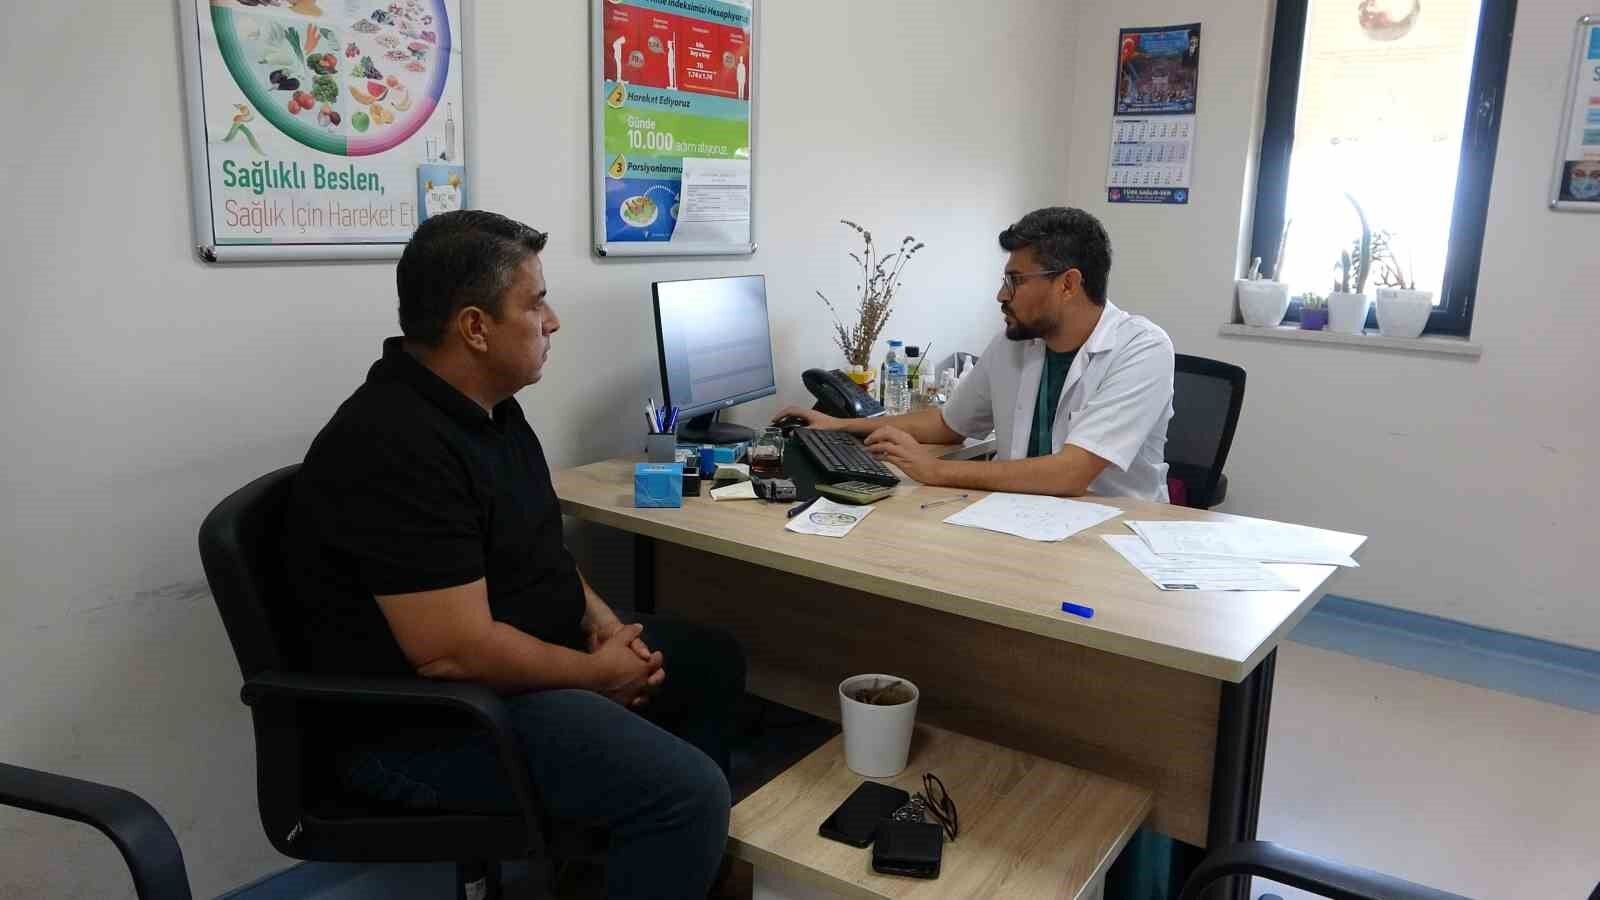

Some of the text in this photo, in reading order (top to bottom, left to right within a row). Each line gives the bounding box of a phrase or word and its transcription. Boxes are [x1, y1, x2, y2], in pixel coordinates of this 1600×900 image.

[615, 92, 622, 102] 2
[627, 93, 691, 109] Hareket Ediyoruz
[627, 115, 656, 129] Günde
[627, 130, 673, 151] 10.000
[616, 163, 623, 173] 3
[222, 160, 385, 196] Sağlıklı Beslen,
[224, 200, 284, 233] Sağlık
[329, 201, 396, 229] Hareket
